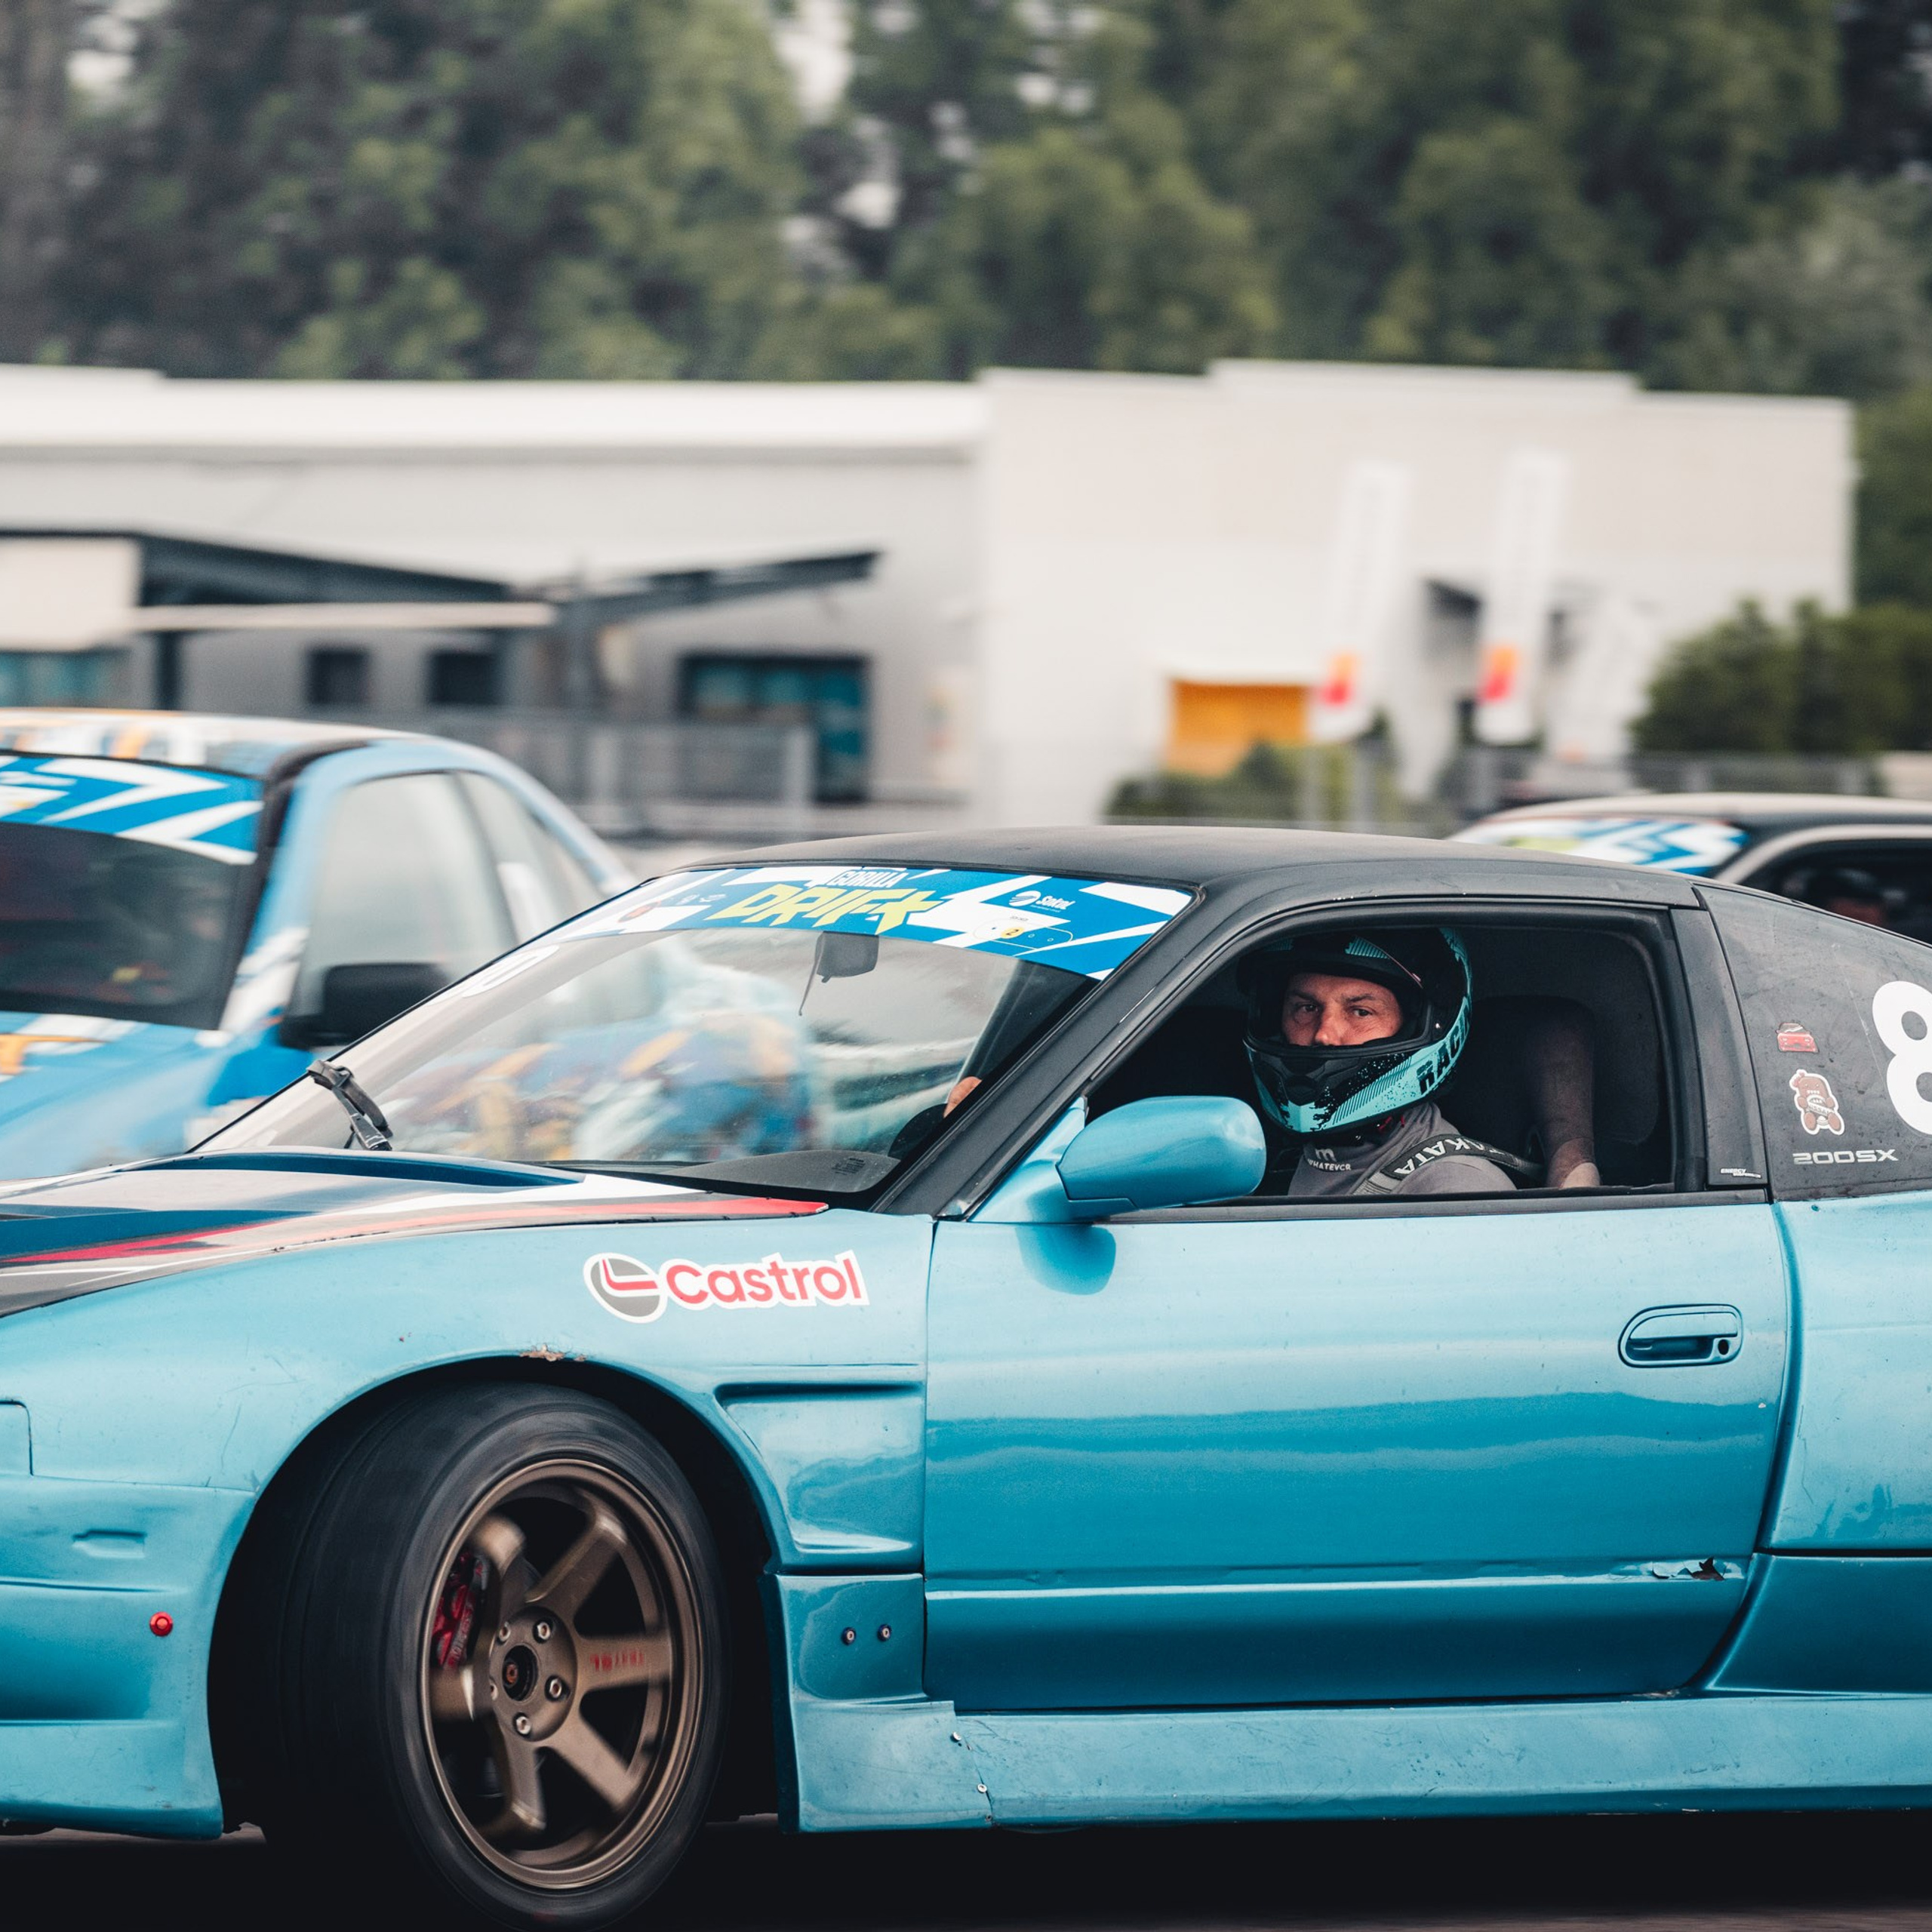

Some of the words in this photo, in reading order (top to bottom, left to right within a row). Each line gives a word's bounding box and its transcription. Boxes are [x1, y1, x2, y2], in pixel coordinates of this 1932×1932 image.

[830, 870, 909, 888] GORILLA
[703, 884, 943, 935] DRIFT
[1872, 980, 1932, 1135] 8
[1792, 1149, 1899, 1165] 200SX
[666, 1258, 861, 1304] Castrol
